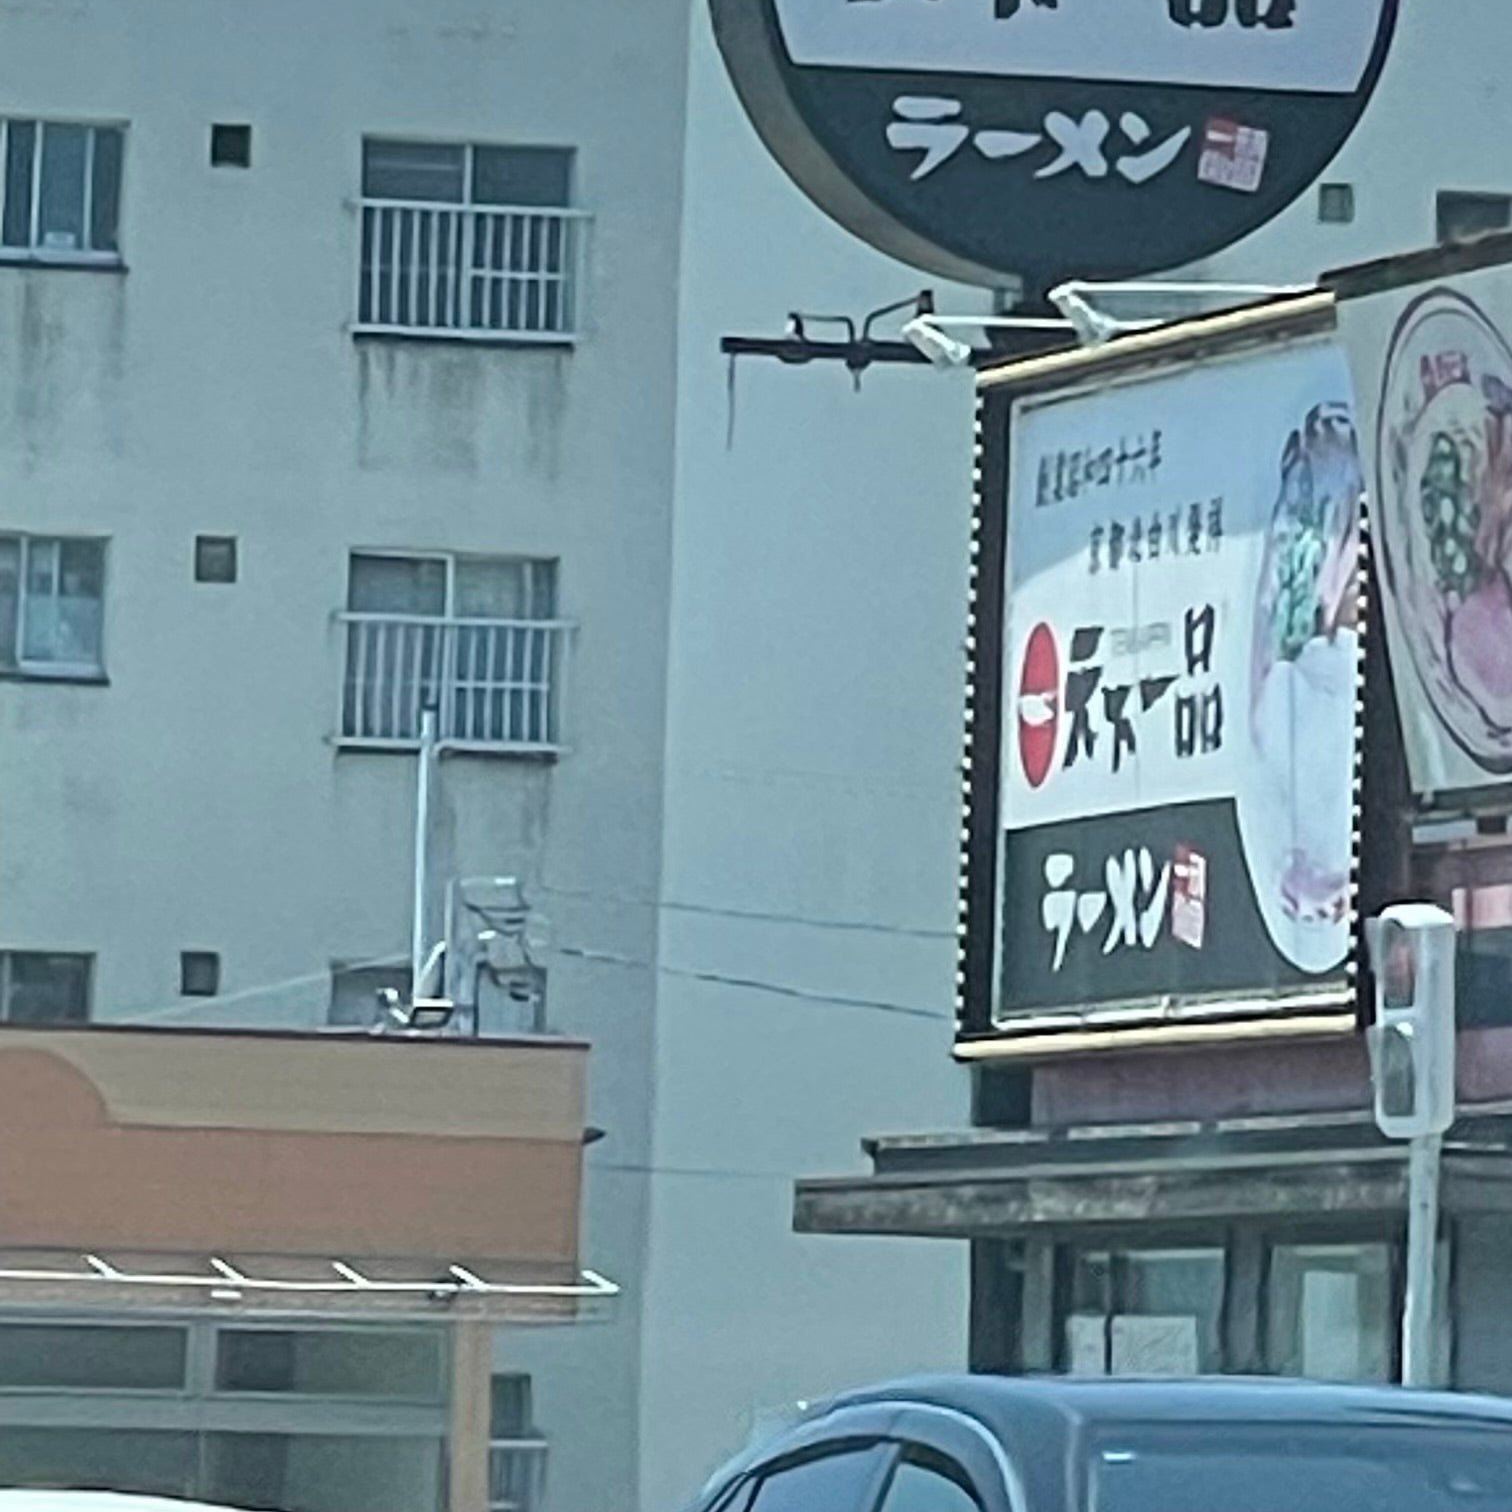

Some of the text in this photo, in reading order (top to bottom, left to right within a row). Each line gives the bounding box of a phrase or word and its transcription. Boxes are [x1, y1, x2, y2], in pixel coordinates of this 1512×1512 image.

[886, 95, 1192, 184] ラーメン
[1062, 602, 1223, 774] 天下一品
[1042, 846, 1172, 972] ラーメン
